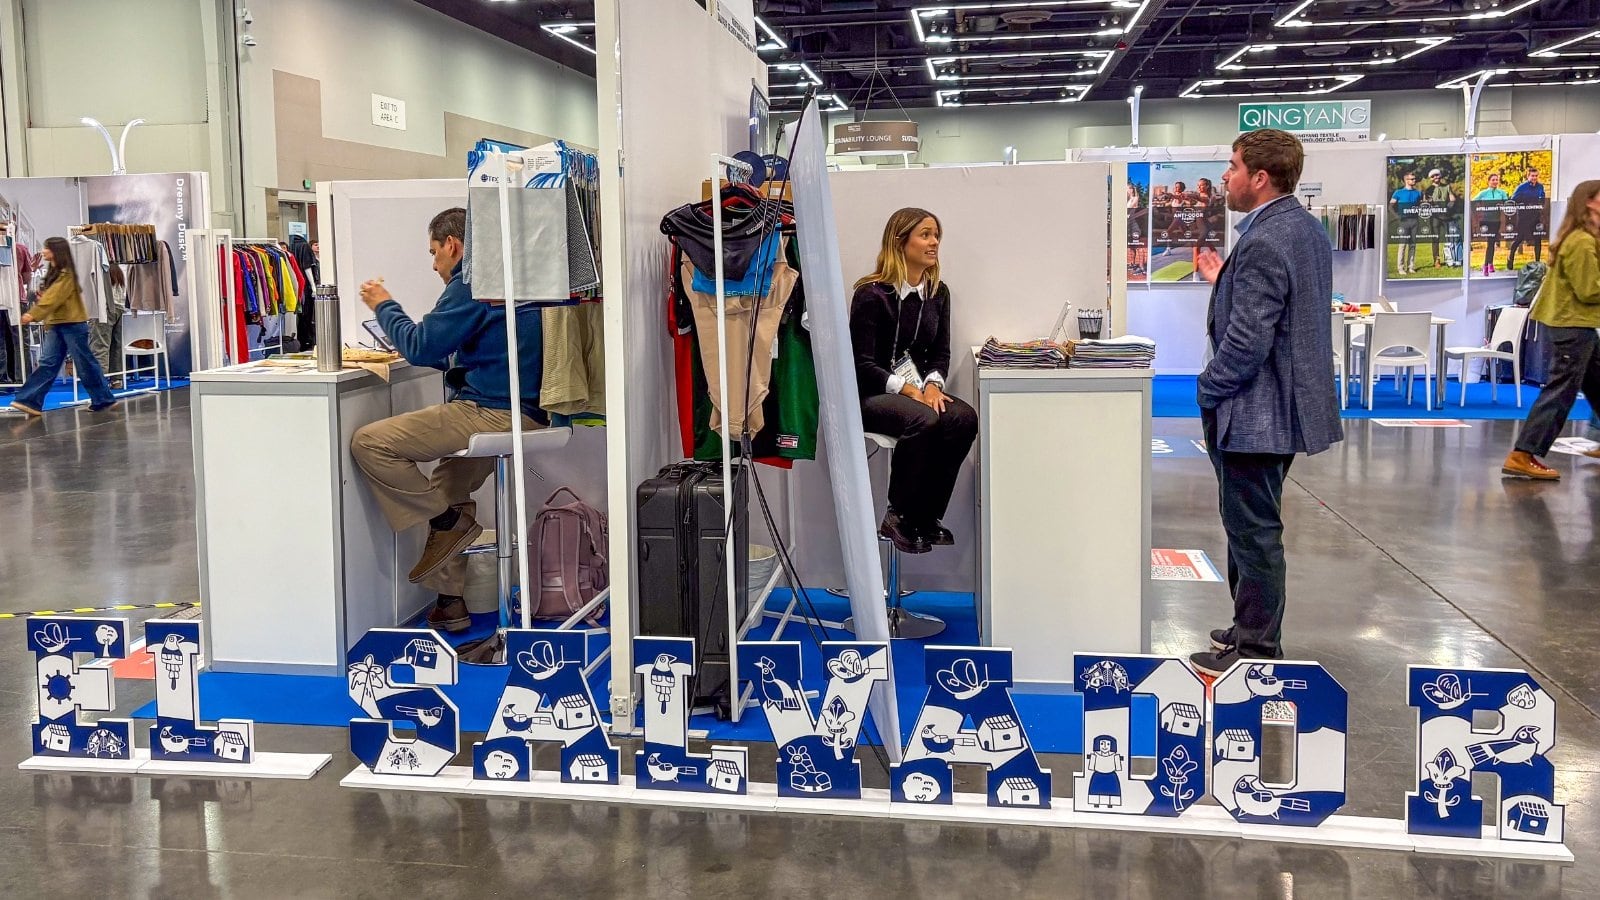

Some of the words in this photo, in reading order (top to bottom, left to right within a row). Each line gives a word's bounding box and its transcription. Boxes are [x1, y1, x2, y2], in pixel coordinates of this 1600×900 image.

[1243, 106, 1367, 127] QINGYANG
[175, 178, 185, 222] Dreamy
[27, 617, 255, 763] EL
[347, 627, 1566, 843] SALVADOR
